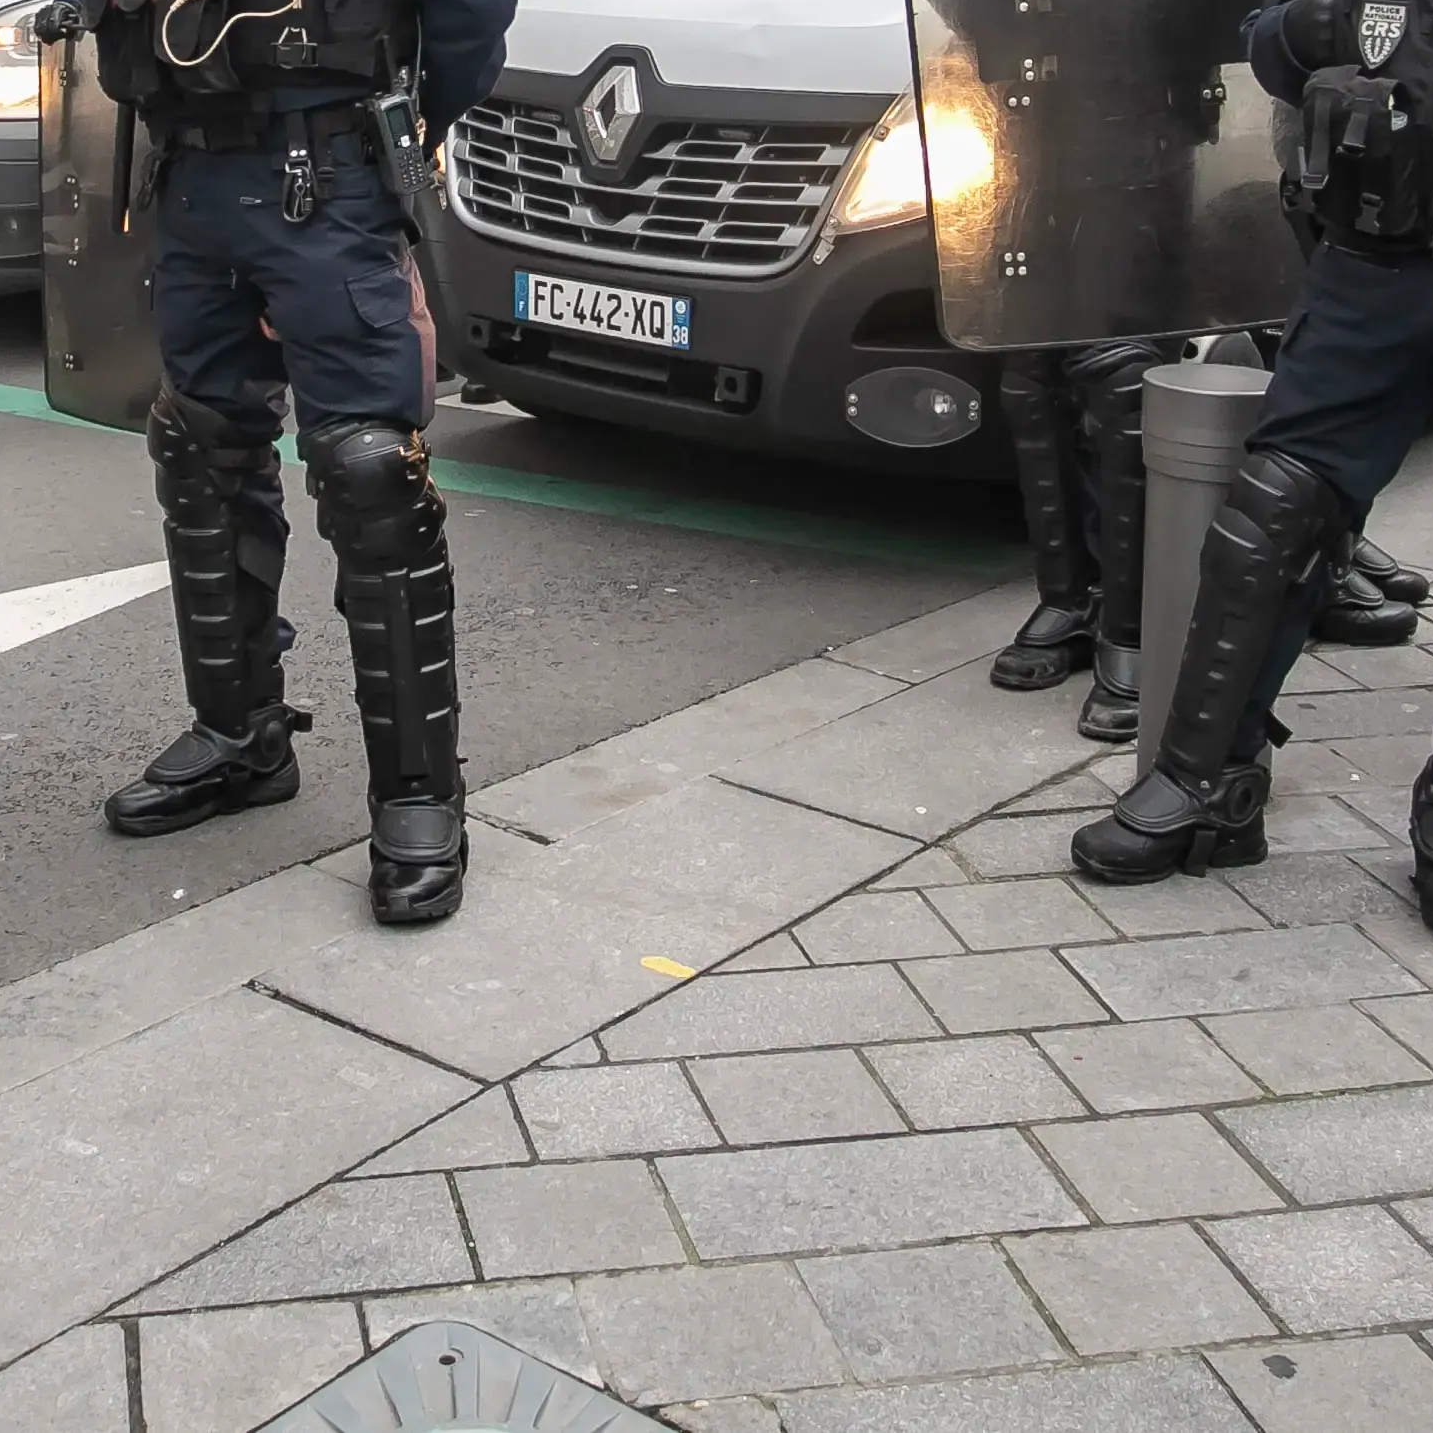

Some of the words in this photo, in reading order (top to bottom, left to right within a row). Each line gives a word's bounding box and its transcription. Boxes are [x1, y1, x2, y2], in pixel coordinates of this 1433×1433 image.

[1369, 5, 1401, 15] POLICE
[1361, 20, 1401, 38] CRS
[533, 279, 665, 340] FC-442-XQ
[672, 324, 689, 345] 38
